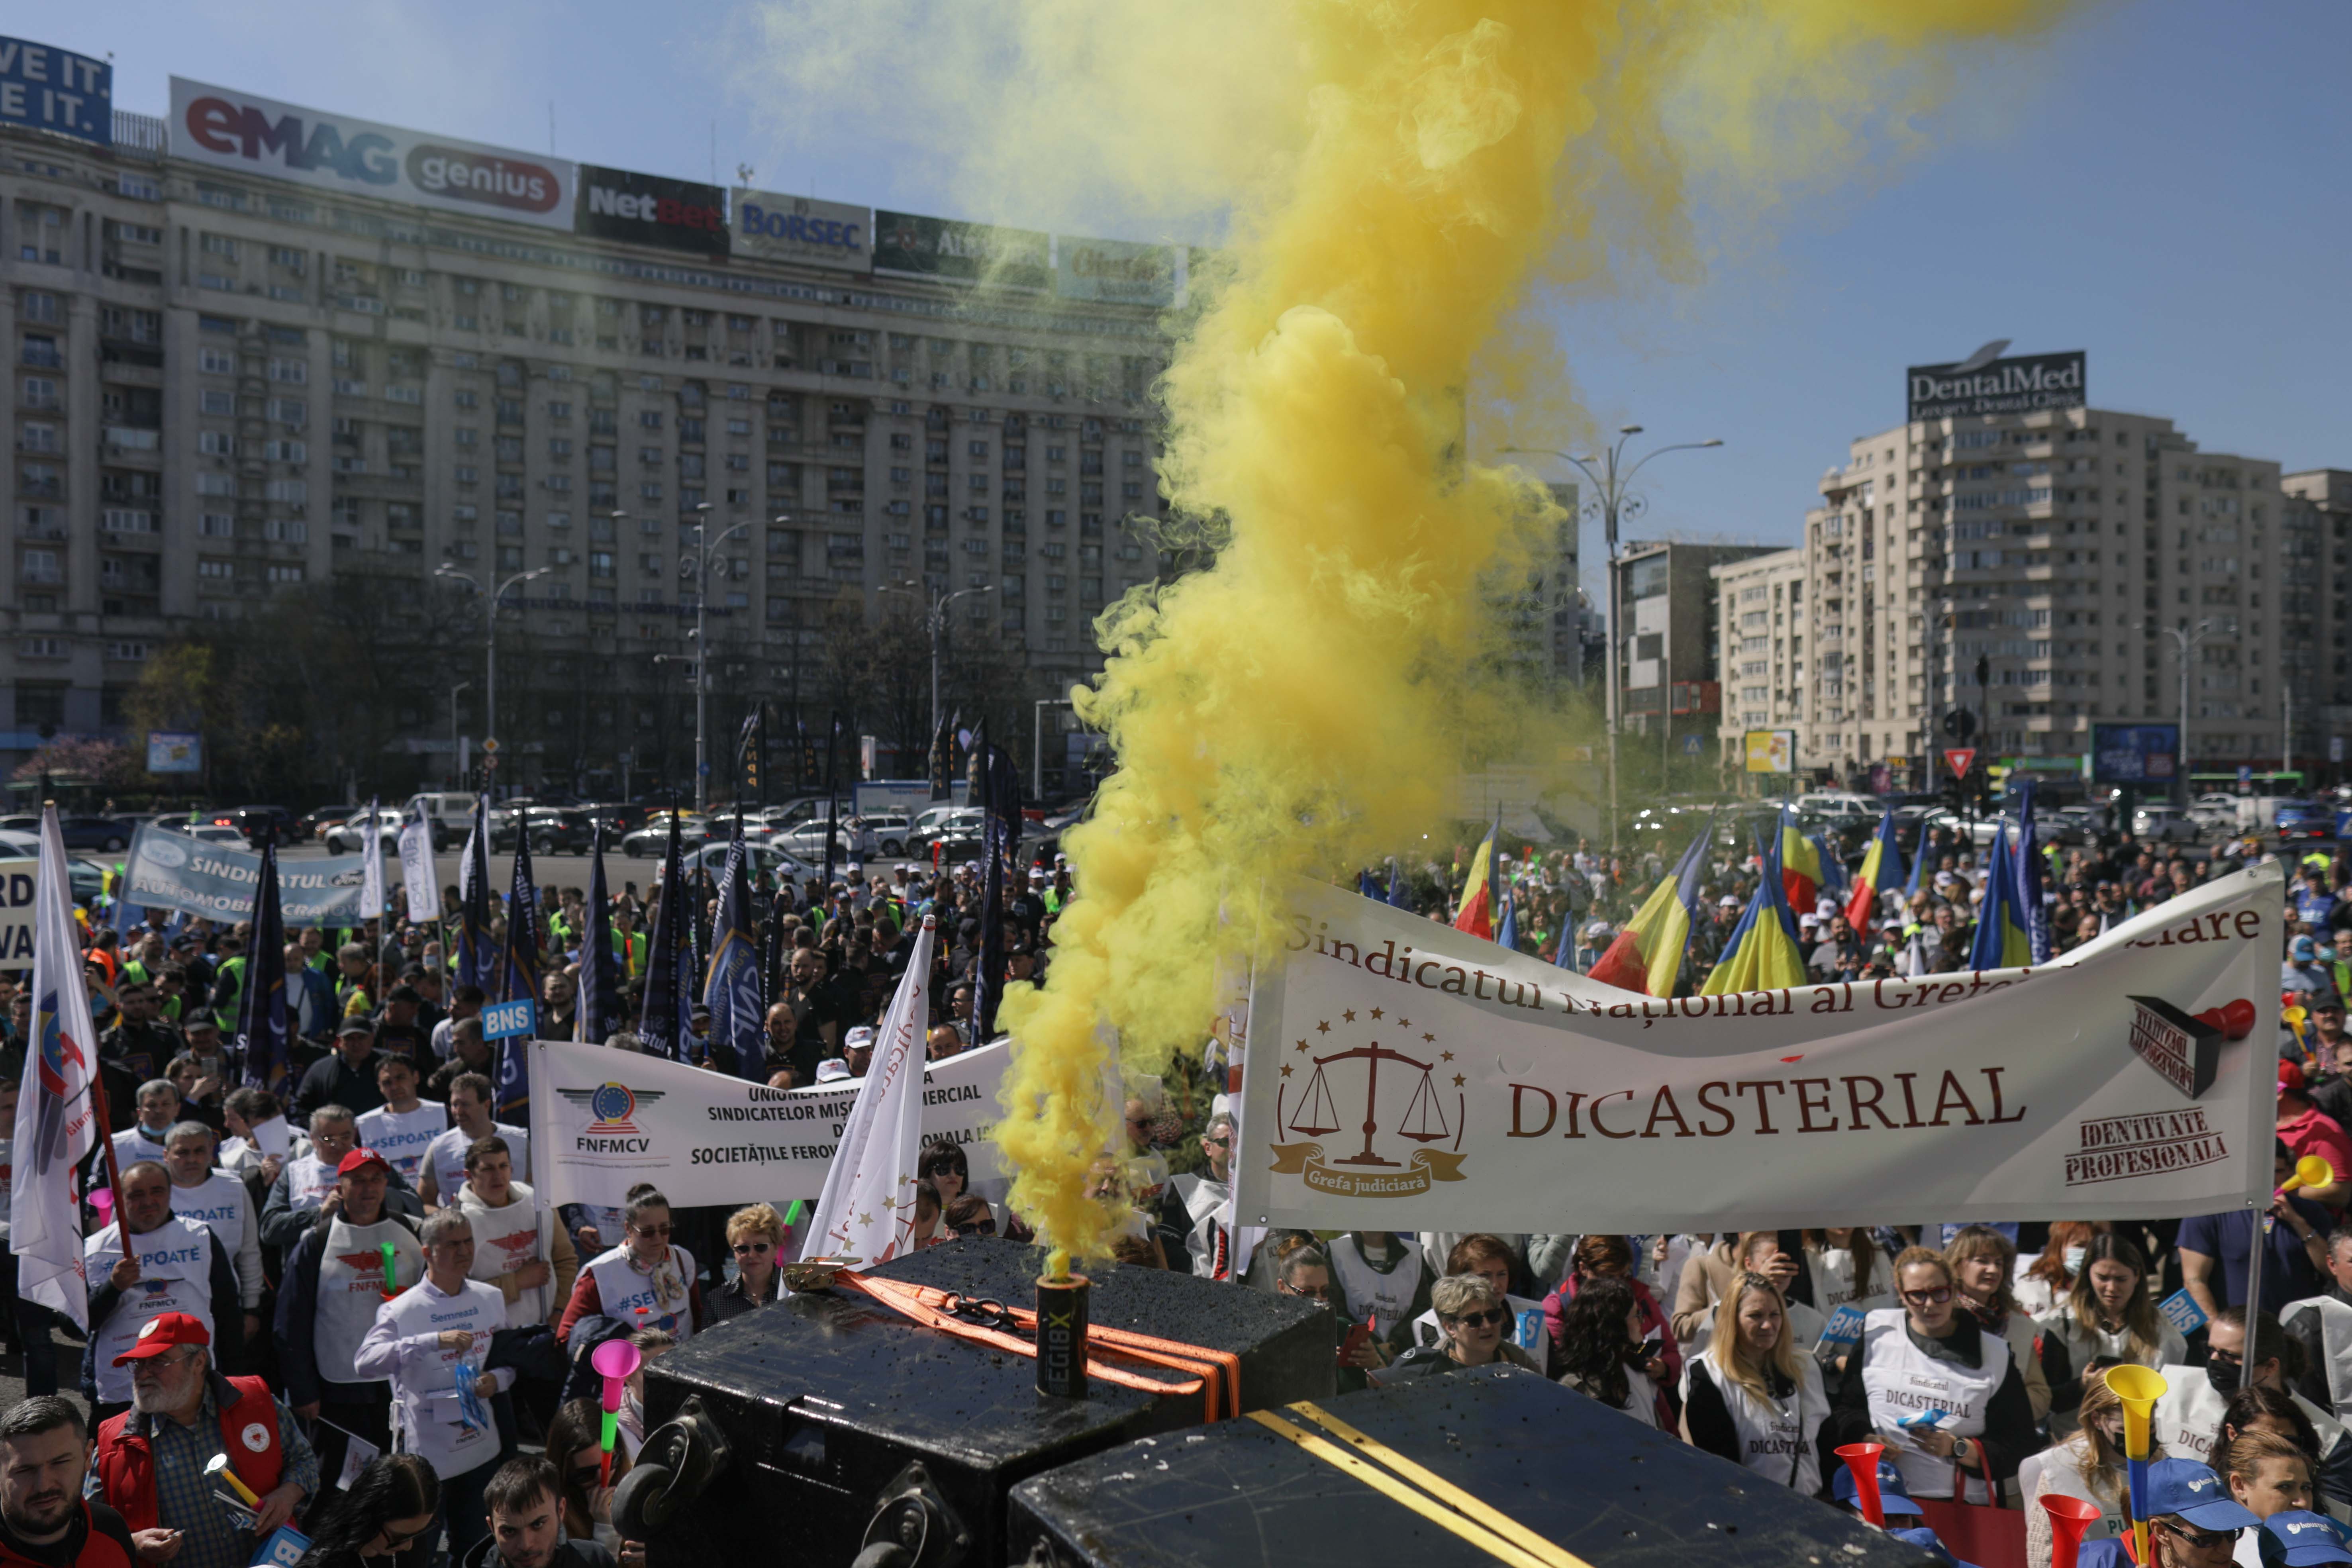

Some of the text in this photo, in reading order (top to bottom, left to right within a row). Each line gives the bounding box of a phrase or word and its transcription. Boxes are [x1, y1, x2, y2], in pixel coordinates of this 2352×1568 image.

[63, 55, 110, 99] IT.
[43, 88, 94, 132] IT.
[186, 96, 546, 202] eMAG genius
[589, 185, 722, 231] NetBet
[743, 204, 860, 249] BORSEC
[1911, 360, 2082, 402] DentalMed
[1974, 395, 2029, 412] Dental
[2033, 392, 2082, 407] Clinic
[188, 857, 327, 888] SINDIATUL
[132, 878, 361, 917] AUTOMOBI CRAIOV
[1284, 913, 1545, 1011] Sindicatul
[1811, 982, 1854, 1014] al
[486, 1005, 529, 1034] BNS
[708, 1105, 814, 1121] SINDICATELOR
[1507, 1066, 2026, 1139] DICASTERIAL
[576, 1137, 650, 1153] FNFMCV
[2080, 1110, 2208, 1148] IDENTITATE
[691, 1143, 788, 1166] SOCIETĂȚILE
[792, 1144, 839, 1160] FEROV
[2065, 1137, 2227, 1182] PROFESIONALA
[1308, 1170, 1427, 1195] Grefa judiciară
[139, 1299, 178, 1310] FNFMCV
[2164, 1296, 2198, 1333] BNS
[1047, 1311, 1071, 1384] EG18X
[1909, 1376, 1949, 1391] Sindicatul
[1886, 1389, 1972, 1419] DICASTERIAL
[2178, 1429, 2214, 1457] DICA
